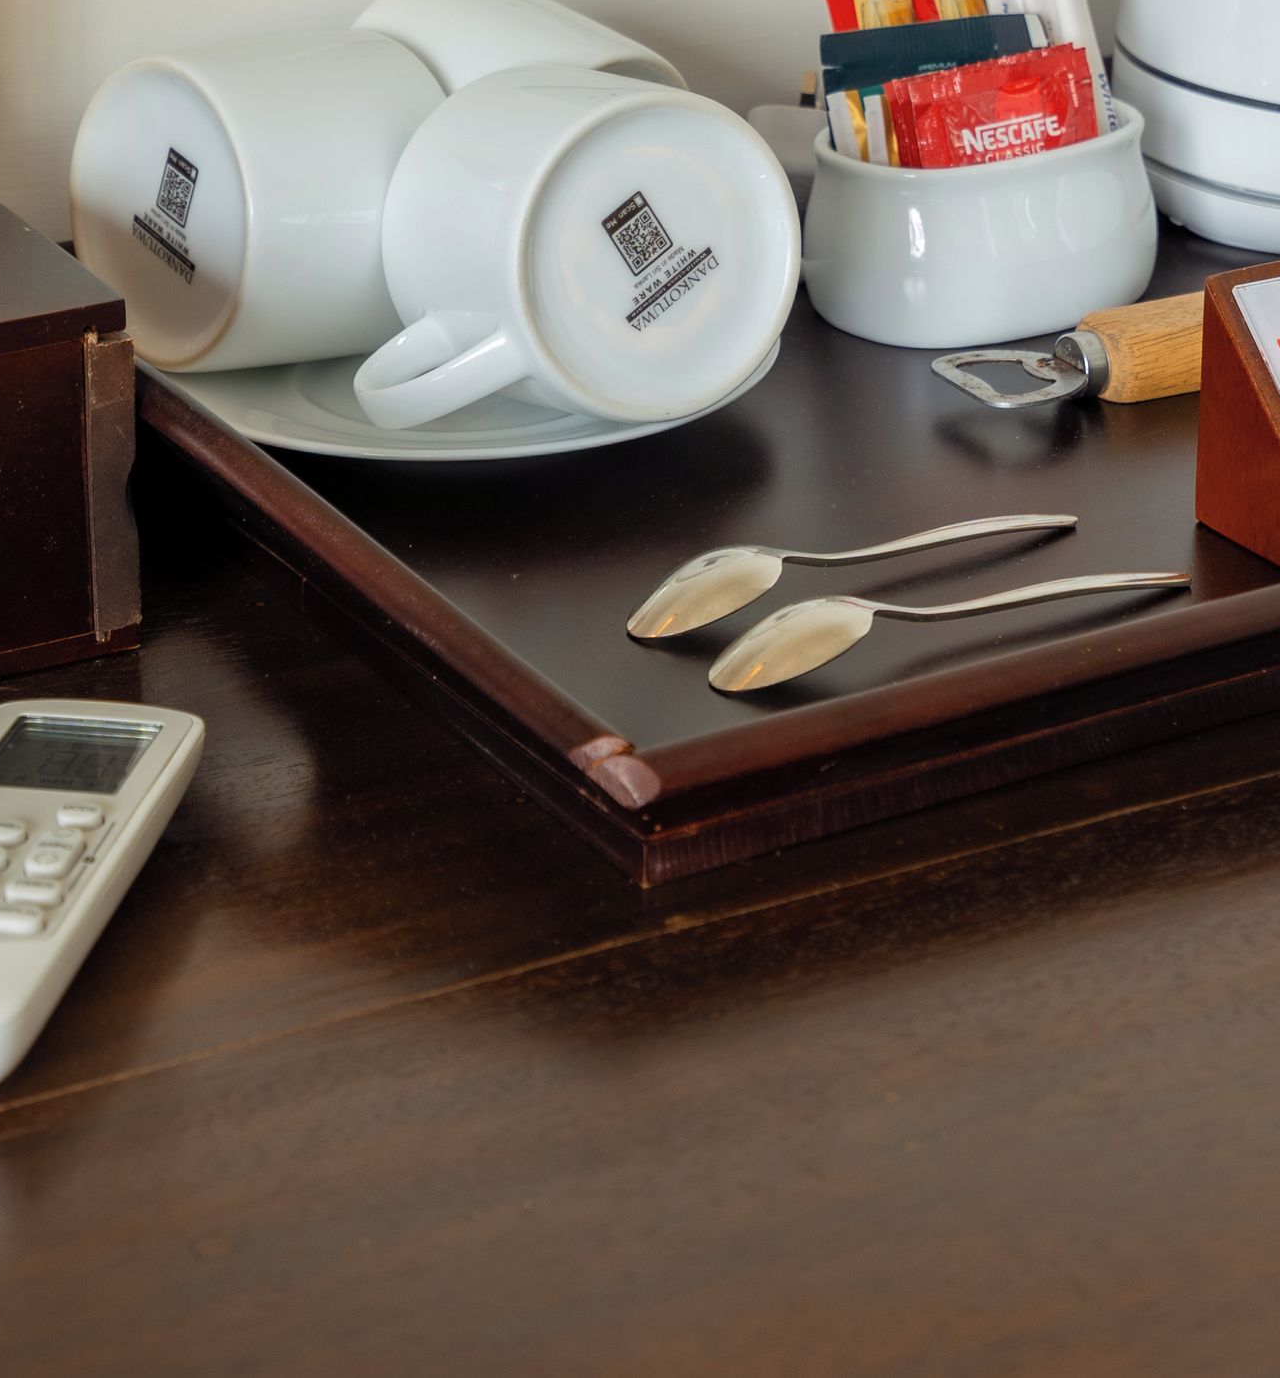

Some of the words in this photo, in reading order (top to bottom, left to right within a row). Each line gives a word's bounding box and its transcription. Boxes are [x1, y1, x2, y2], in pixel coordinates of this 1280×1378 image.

[984, 140, 1046, 164] CLASSIC
[618, 202, 637, 219] Scan
[132, 223, 194, 285] DANKOTUWA
[665, 249, 696, 278] WHITE
[631, 255, 720, 332] DANKOTUWA
[632, 278, 662, 306] WARE
